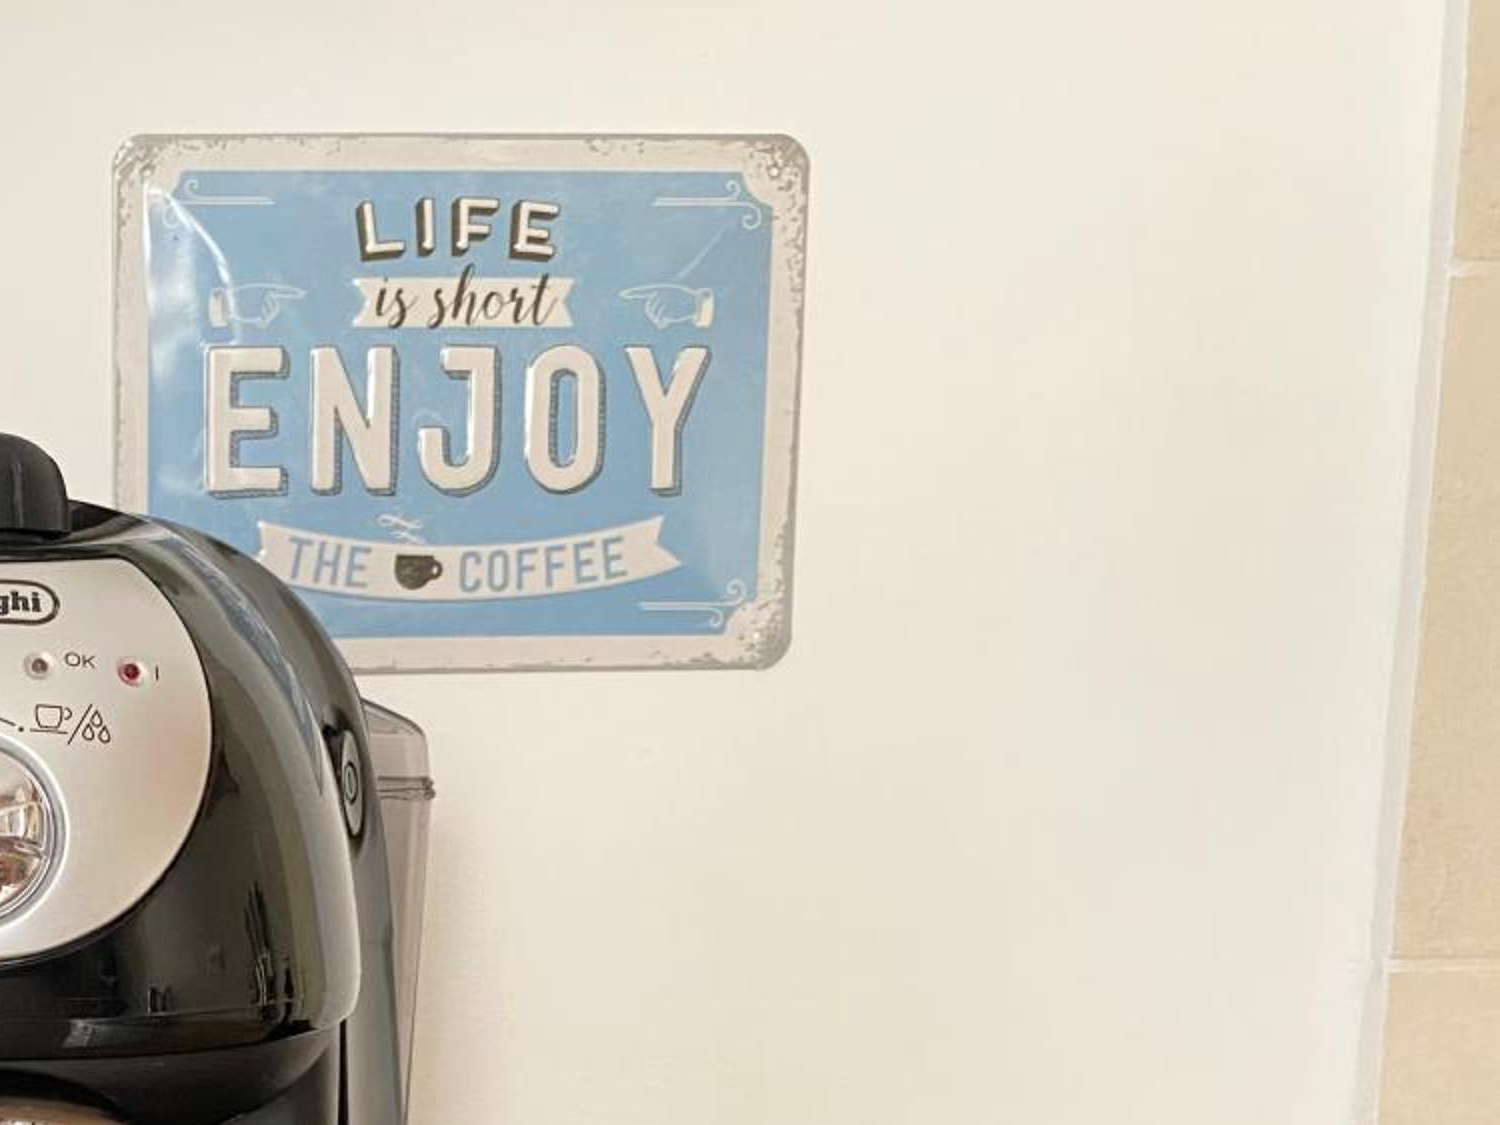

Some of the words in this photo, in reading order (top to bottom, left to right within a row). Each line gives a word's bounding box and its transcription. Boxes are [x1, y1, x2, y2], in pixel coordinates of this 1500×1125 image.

[355, 197, 561, 262] LIFE
[372, 277, 408, 328] is
[427, 263, 558, 329] short
[203, 343, 712, 498] ENJOY
[287, 535, 372, 590] THE
[458, 535, 630, 593] COFFEE
[64, 651, 98, 669] OK
